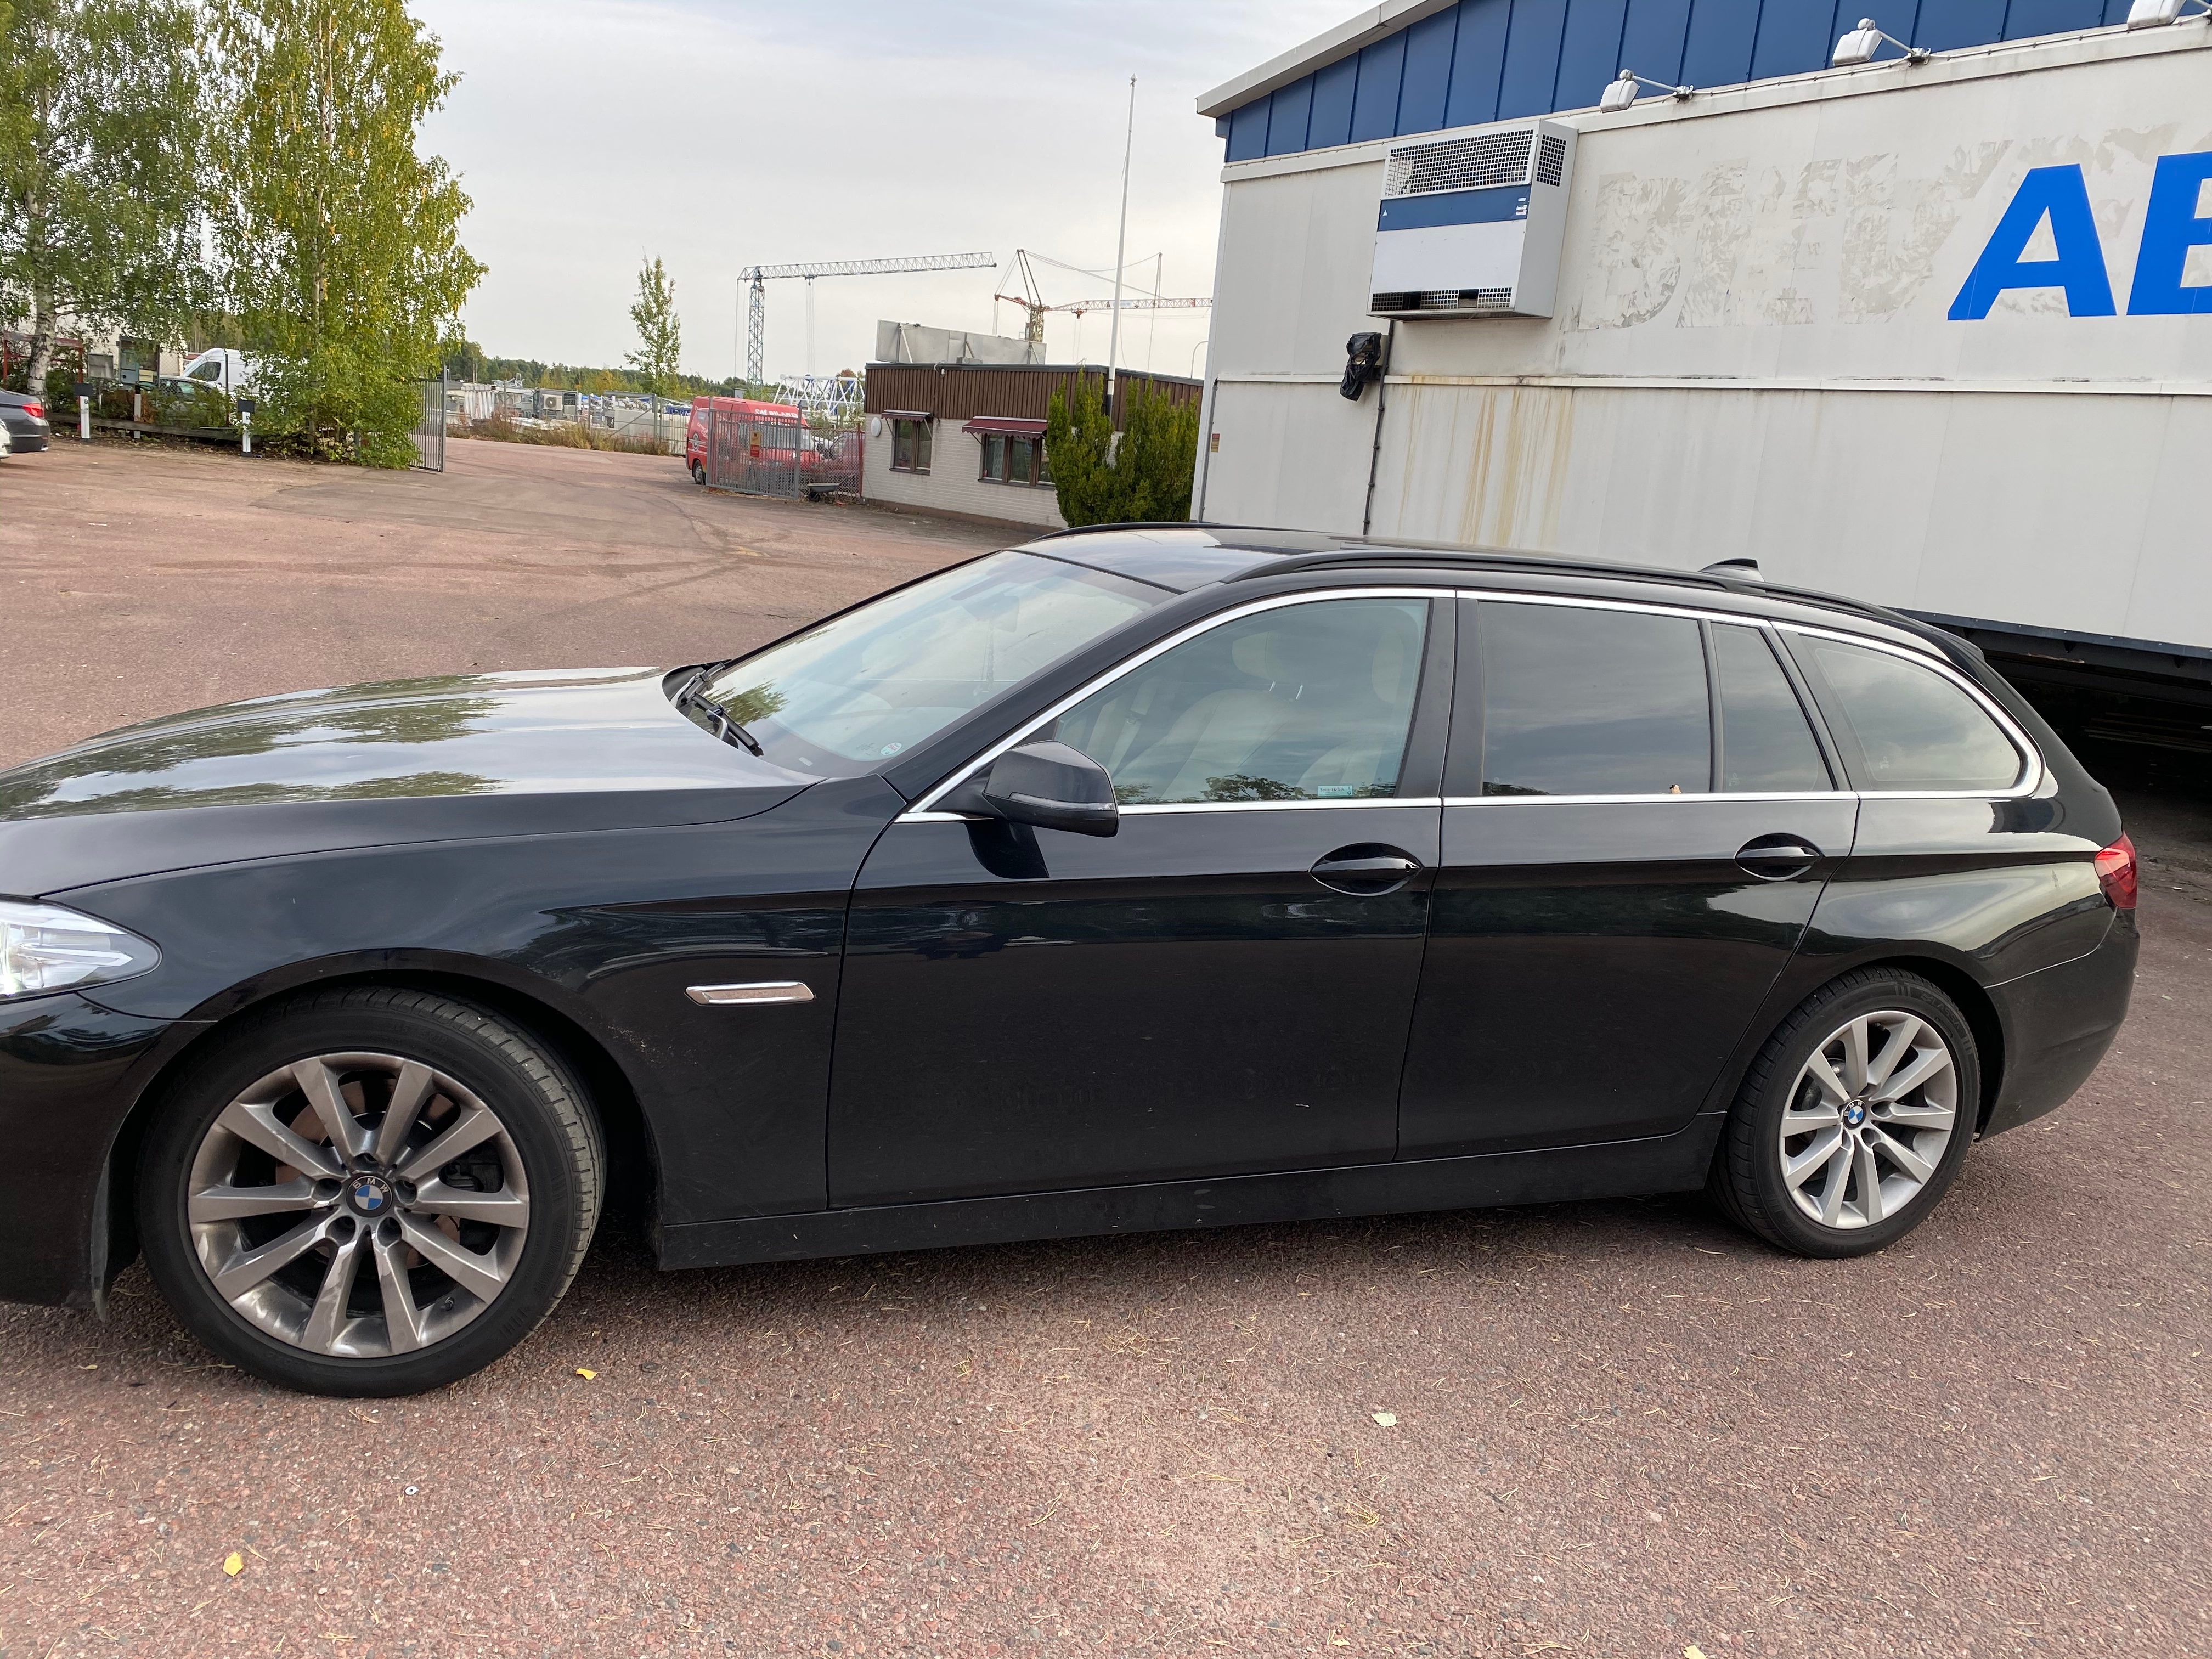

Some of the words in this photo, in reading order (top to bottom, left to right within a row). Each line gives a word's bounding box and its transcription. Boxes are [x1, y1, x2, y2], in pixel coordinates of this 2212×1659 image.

[1931, 997, 1961, 1030] LASSA
[1844, 1101, 1863, 1116] BMW
[352, 1178, 389, 1193] BMW
